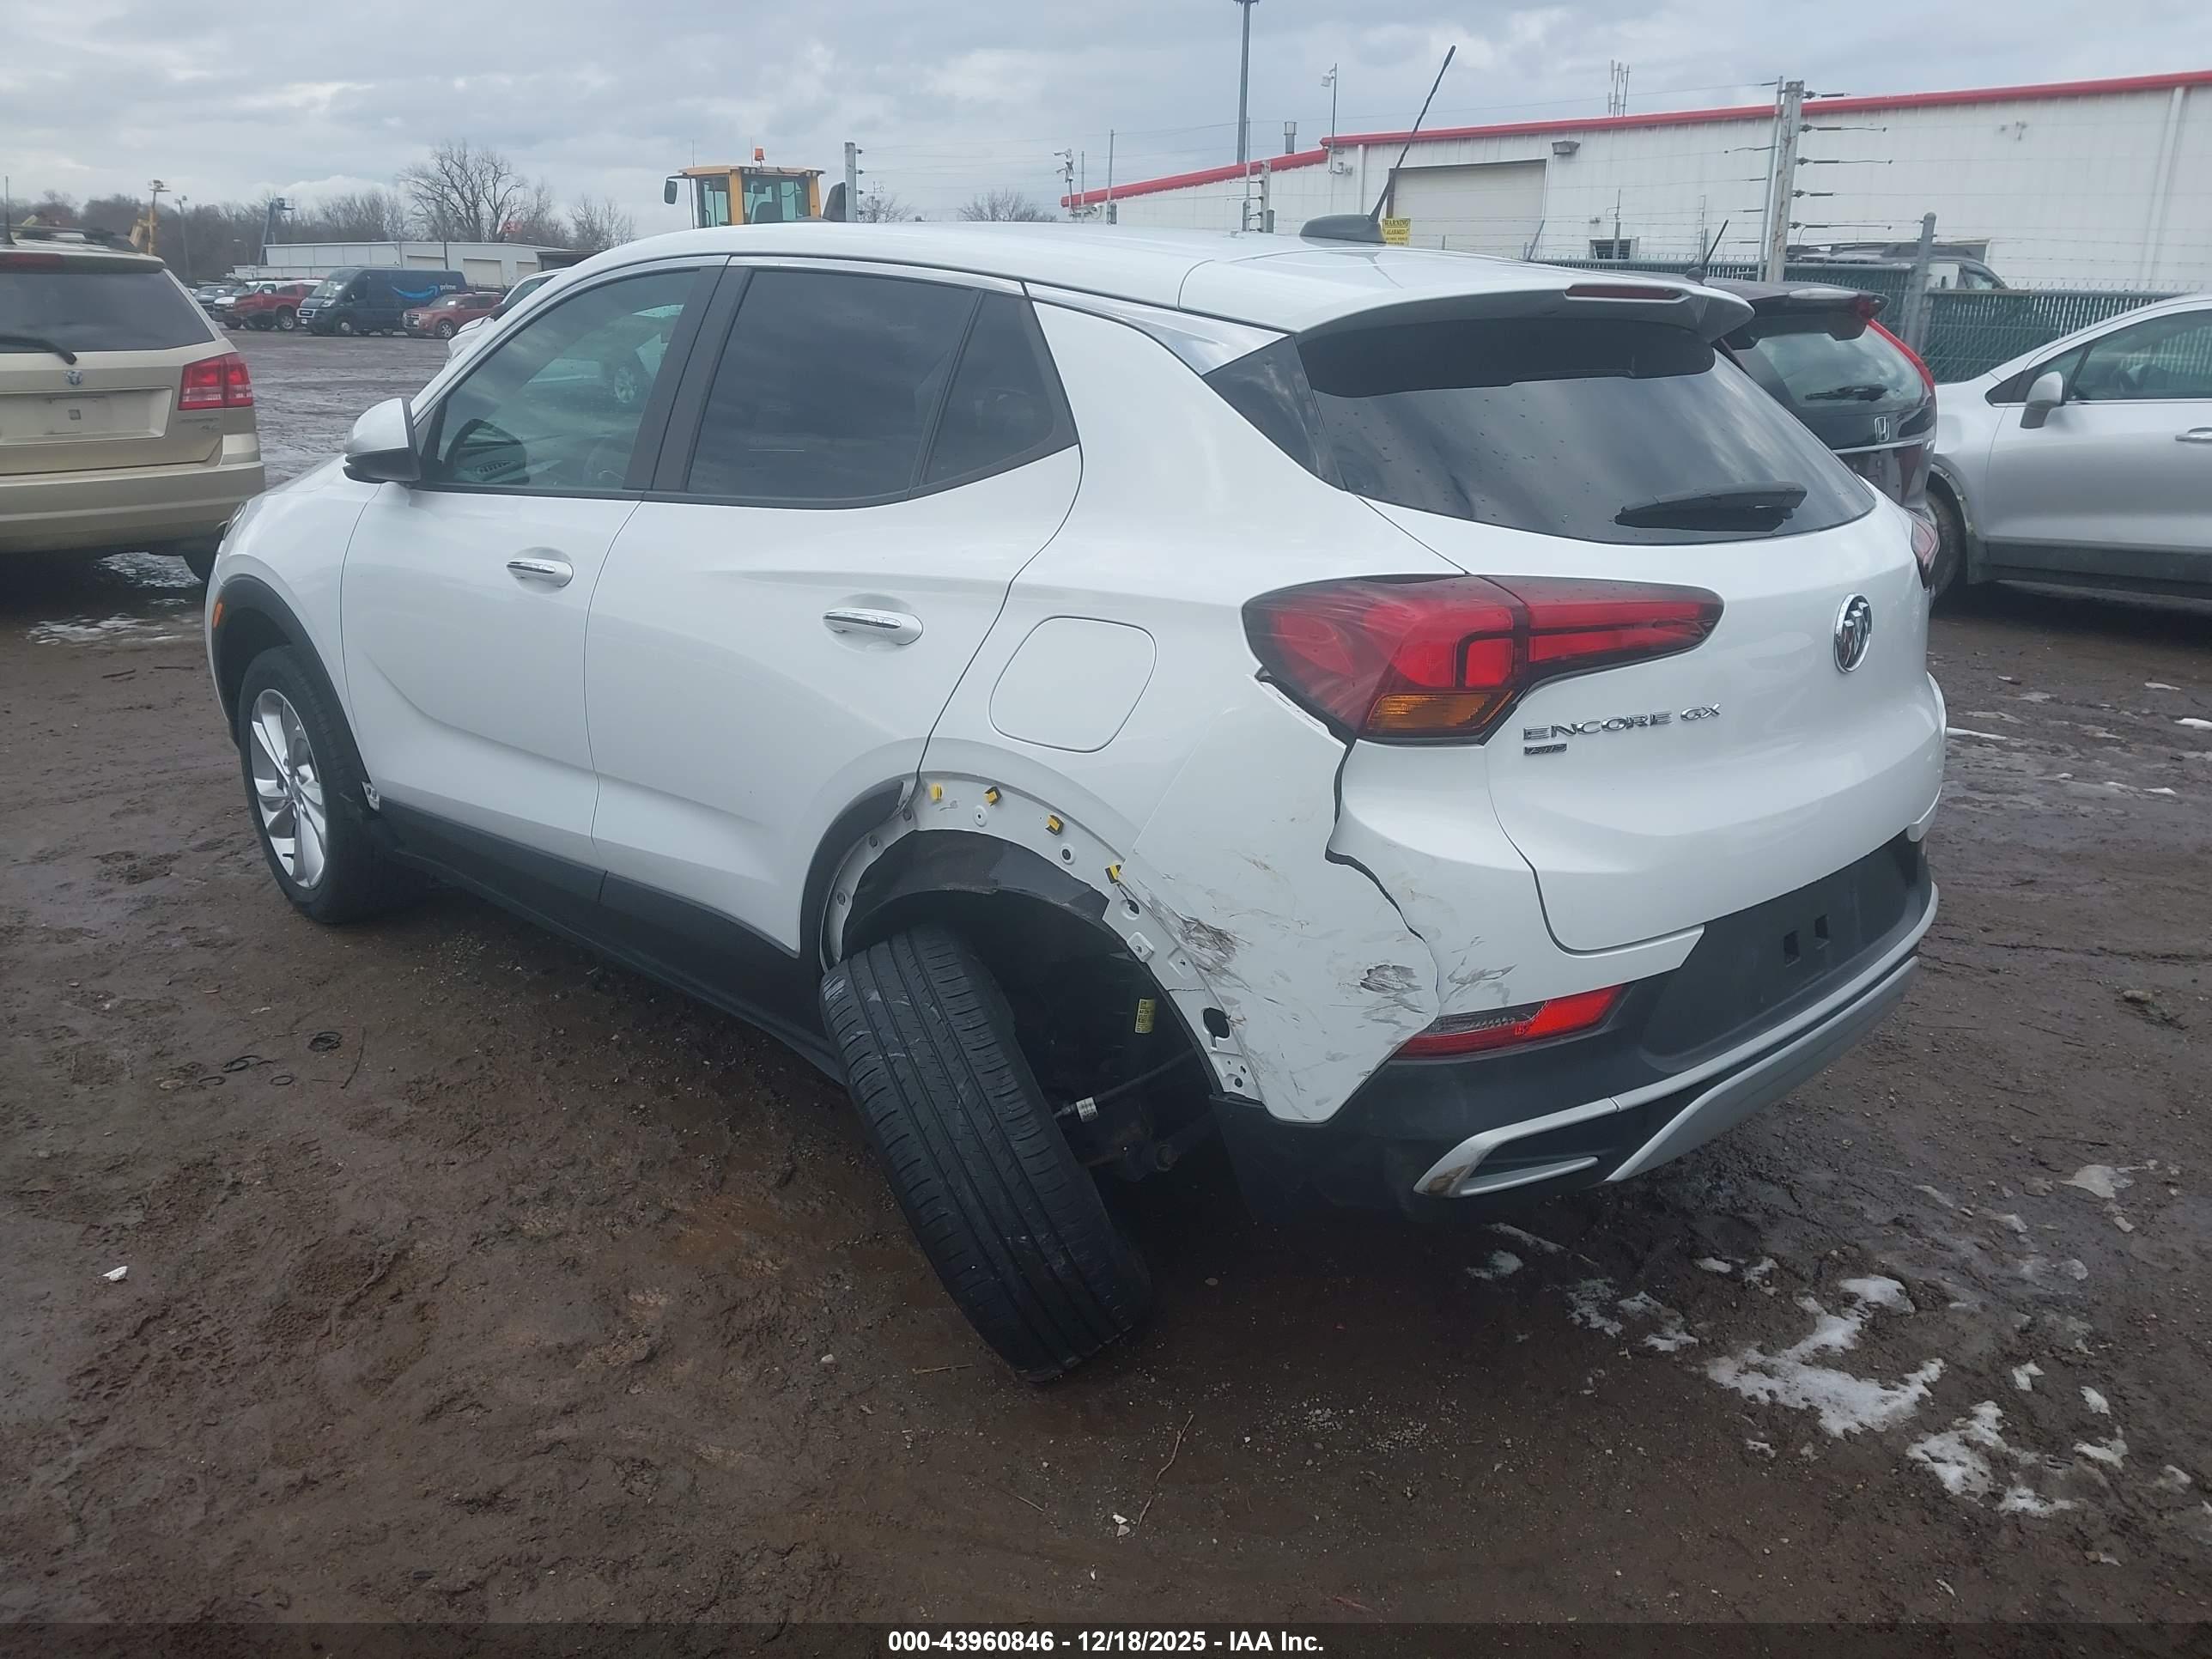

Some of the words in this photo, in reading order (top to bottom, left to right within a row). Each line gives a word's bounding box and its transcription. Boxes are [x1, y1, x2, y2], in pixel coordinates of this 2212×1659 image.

[440, 283, 457, 291] prime
[1523, 711, 1673, 741] ENCORE
[1680, 702, 1721, 722] GX
